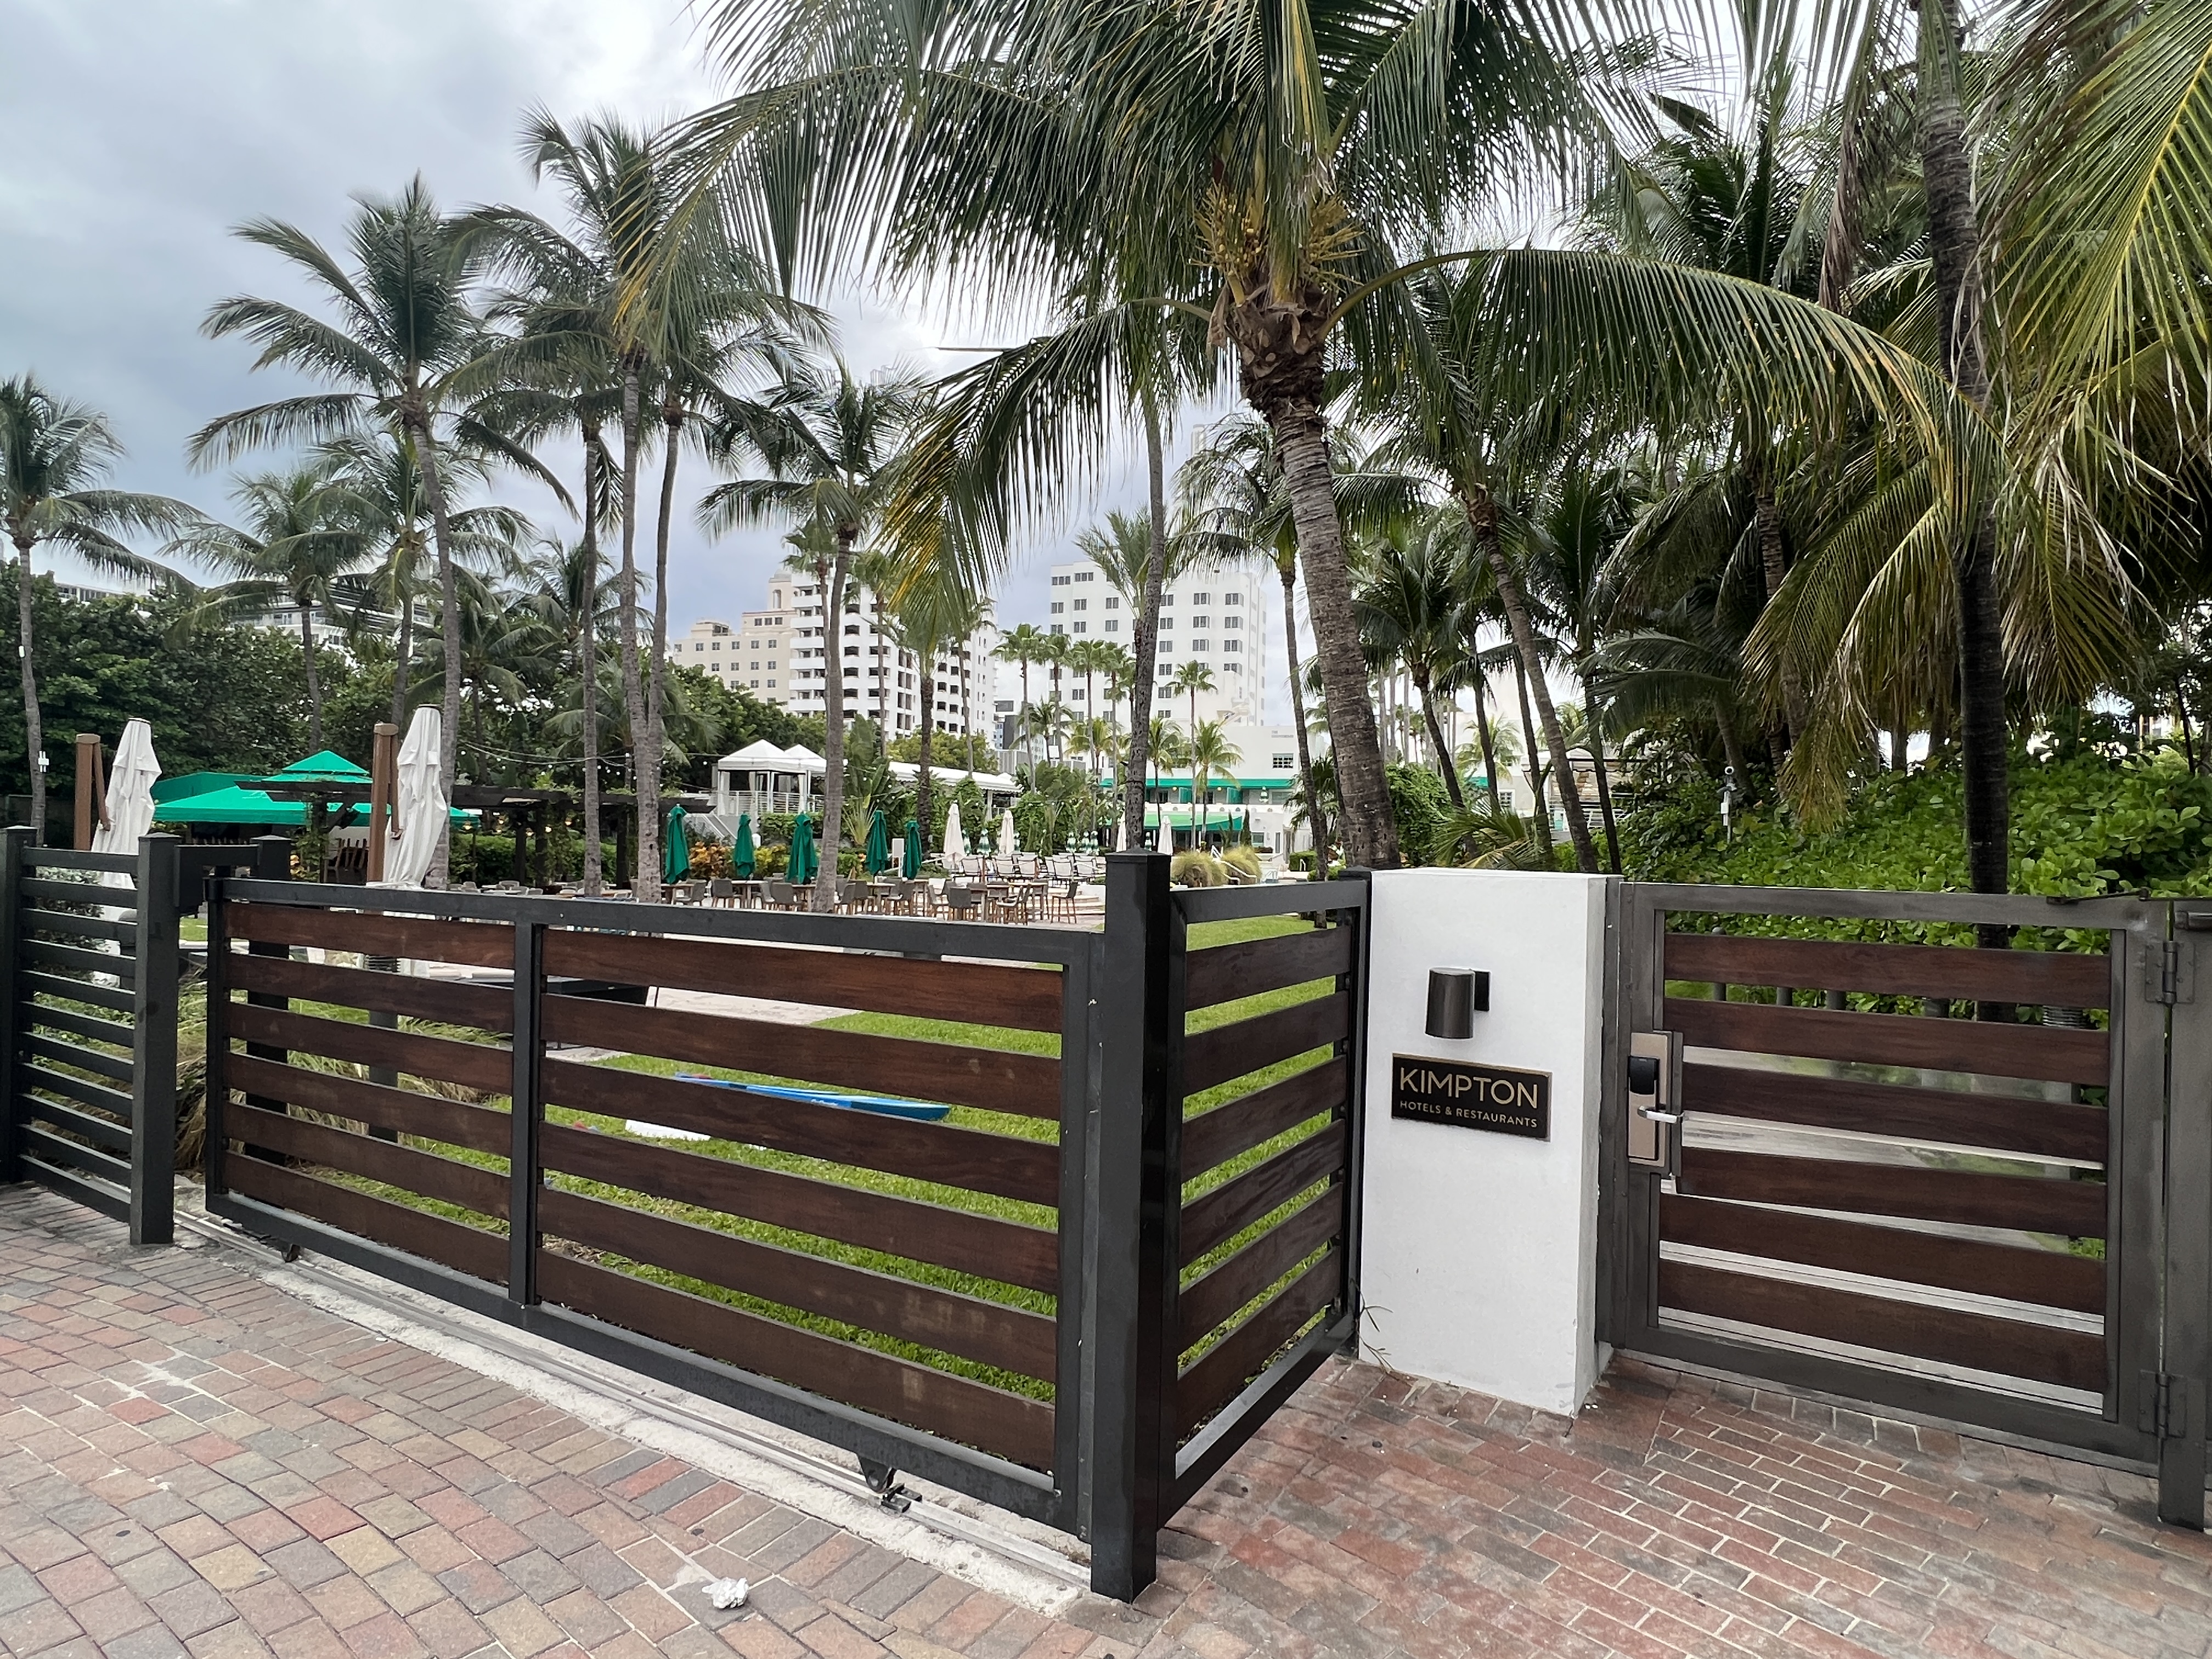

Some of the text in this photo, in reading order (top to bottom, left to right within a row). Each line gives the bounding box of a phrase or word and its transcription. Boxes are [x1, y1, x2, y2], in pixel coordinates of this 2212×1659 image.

[1400, 1067, 1537, 1109] KIMPTON
[1400, 1101, 1537, 1128] HOTELS & RESTAURANTS
